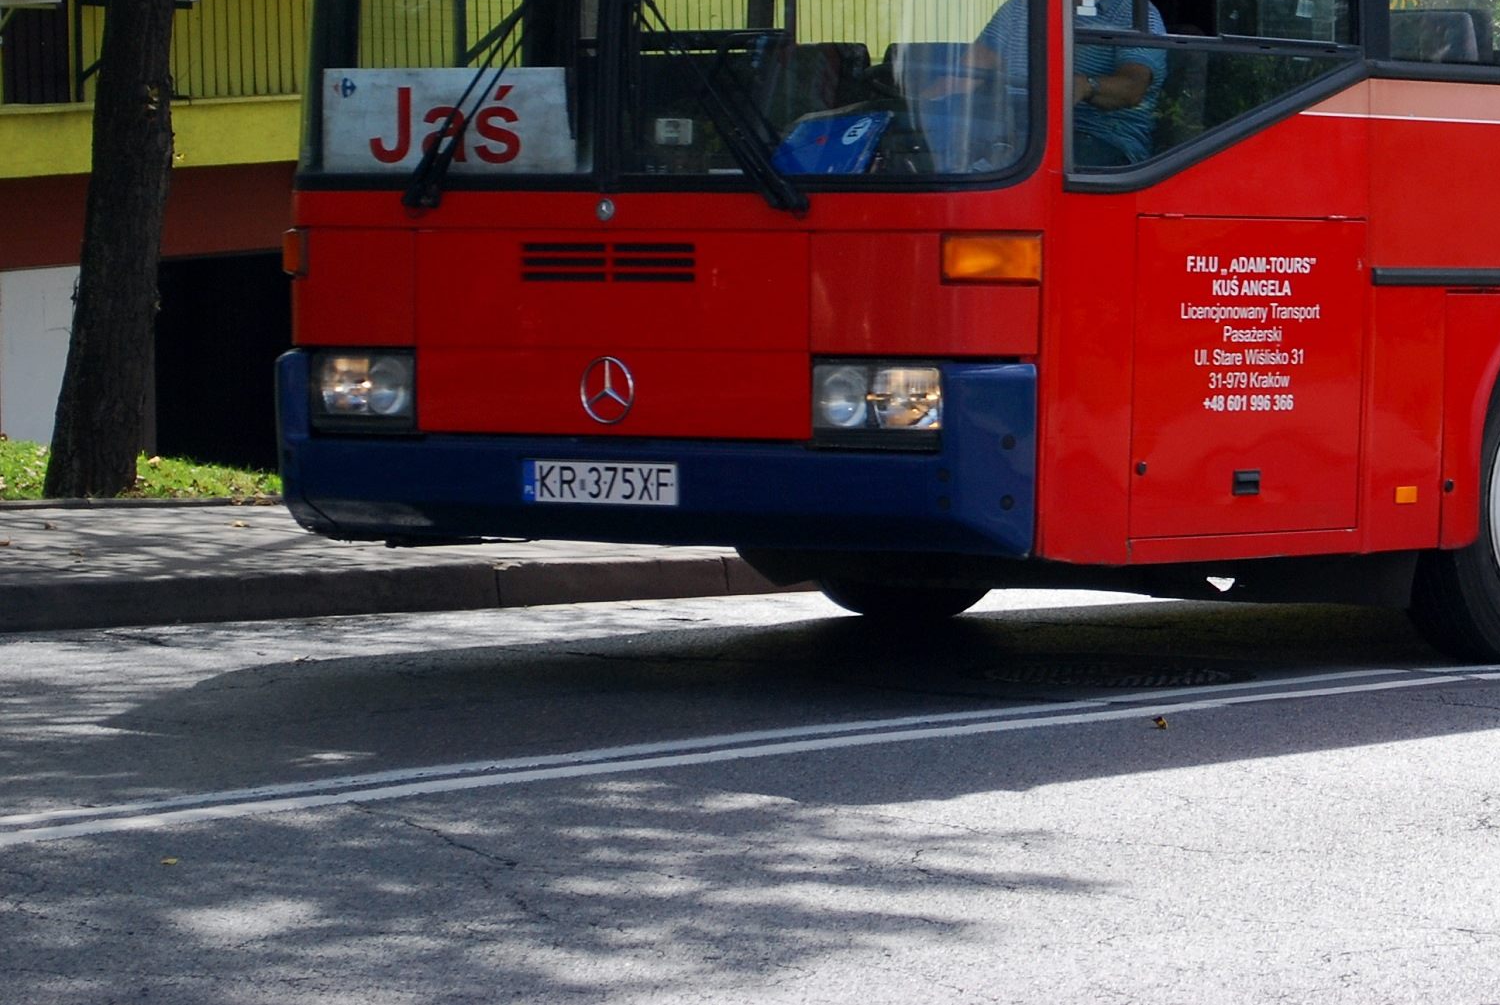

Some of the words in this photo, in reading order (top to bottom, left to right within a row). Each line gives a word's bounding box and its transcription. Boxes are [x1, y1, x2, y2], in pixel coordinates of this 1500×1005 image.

[369, 85, 521, 164] Jaś
[1212, 276, 1239, 296] KUŚ
[1240, 280, 1292, 296] ANGELA
[1180, 302, 1268, 323] Licencjonowany
[1270, 302, 1320, 322] Transport
[1223, 325, 1282, 342] Pasażerski
[1194, 349, 1210, 366] Ul.
[1212, 349, 1242, 366] Stare
[1244, 348, 1289, 365] Wiślisko
[1291, 348, 1304, 365] 31
[1208, 372, 1248, 389] 31-979
[1249, 371, 1290, 388] Kraków
[1203, 395, 1225, 411] +48
[1227, 395, 1248, 411] 601
[1250, 395, 1271, 411] 996
[1273, 394, 1294, 411] 366
[539, 465, 577, 499] KR
[588, 467, 671, 501] 375XF
